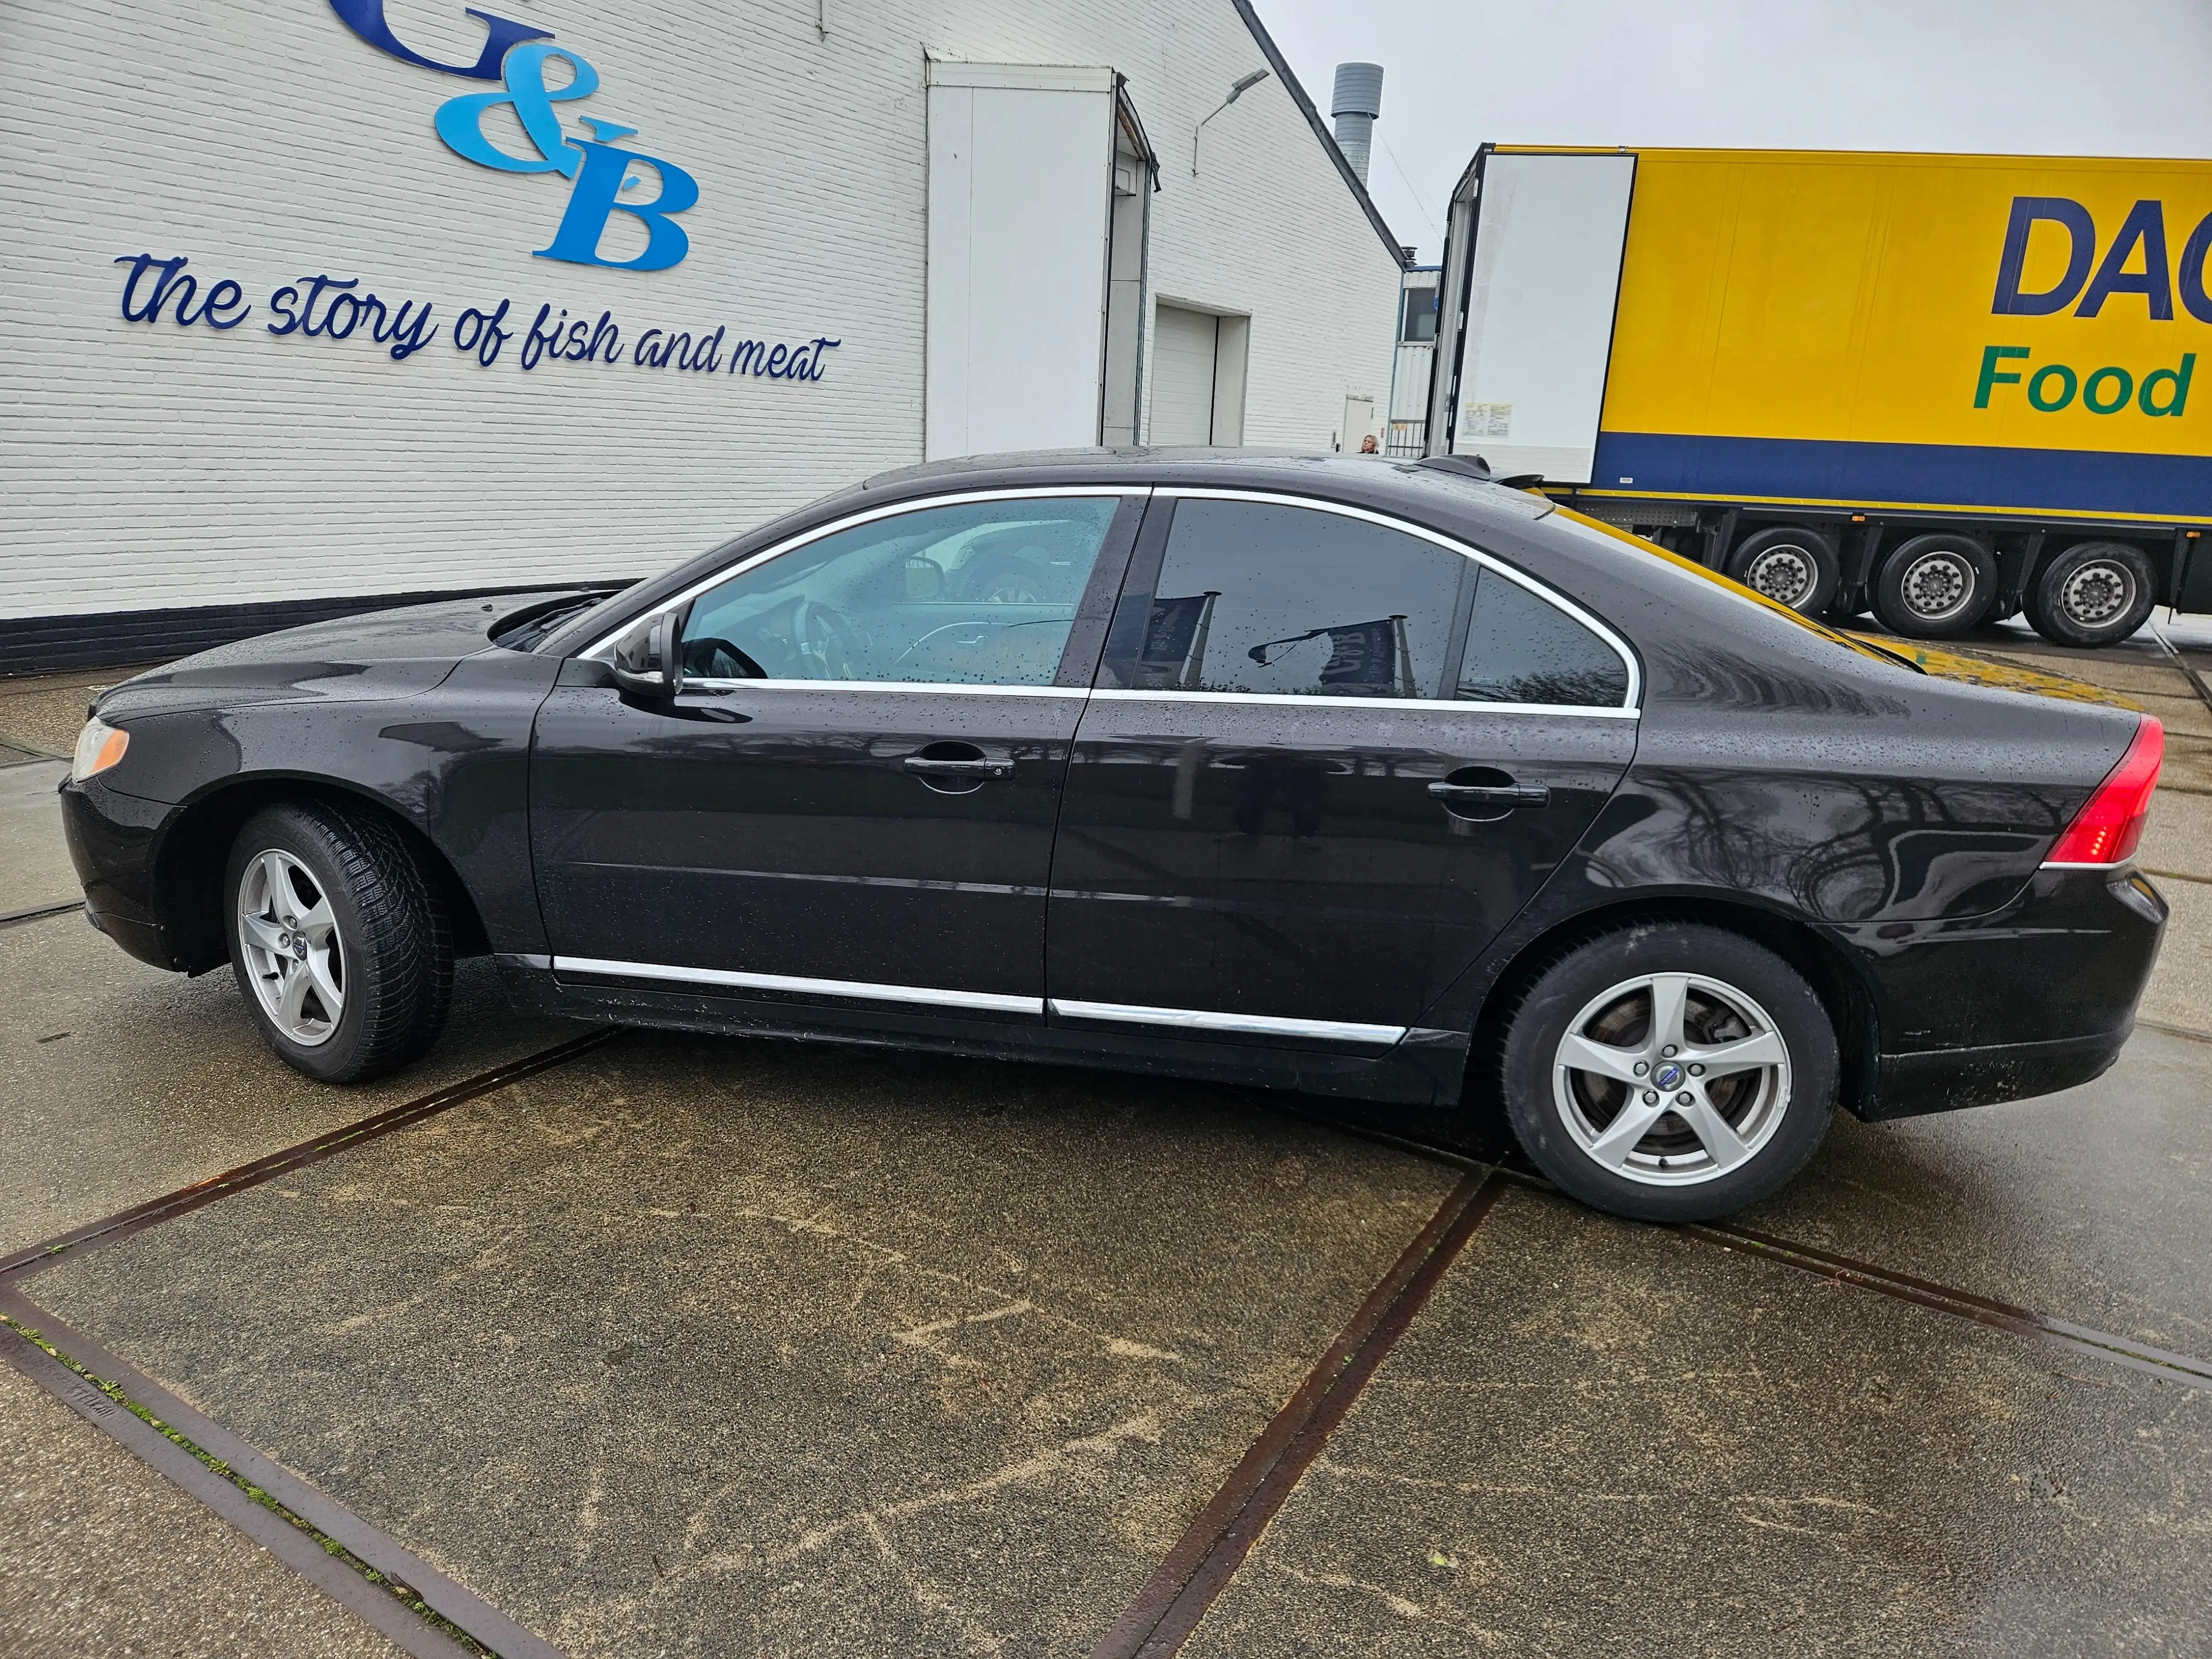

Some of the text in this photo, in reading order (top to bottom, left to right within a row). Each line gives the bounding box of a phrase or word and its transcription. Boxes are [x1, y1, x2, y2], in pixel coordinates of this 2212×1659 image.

[267, 274, 438, 360] story
[454, 299, 513, 367] of
[521, 304, 624, 370] fish
[635, 325, 724, 373] and
[730, 337, 840, 381] meat
[1973, 346, 2196, 417] Food
